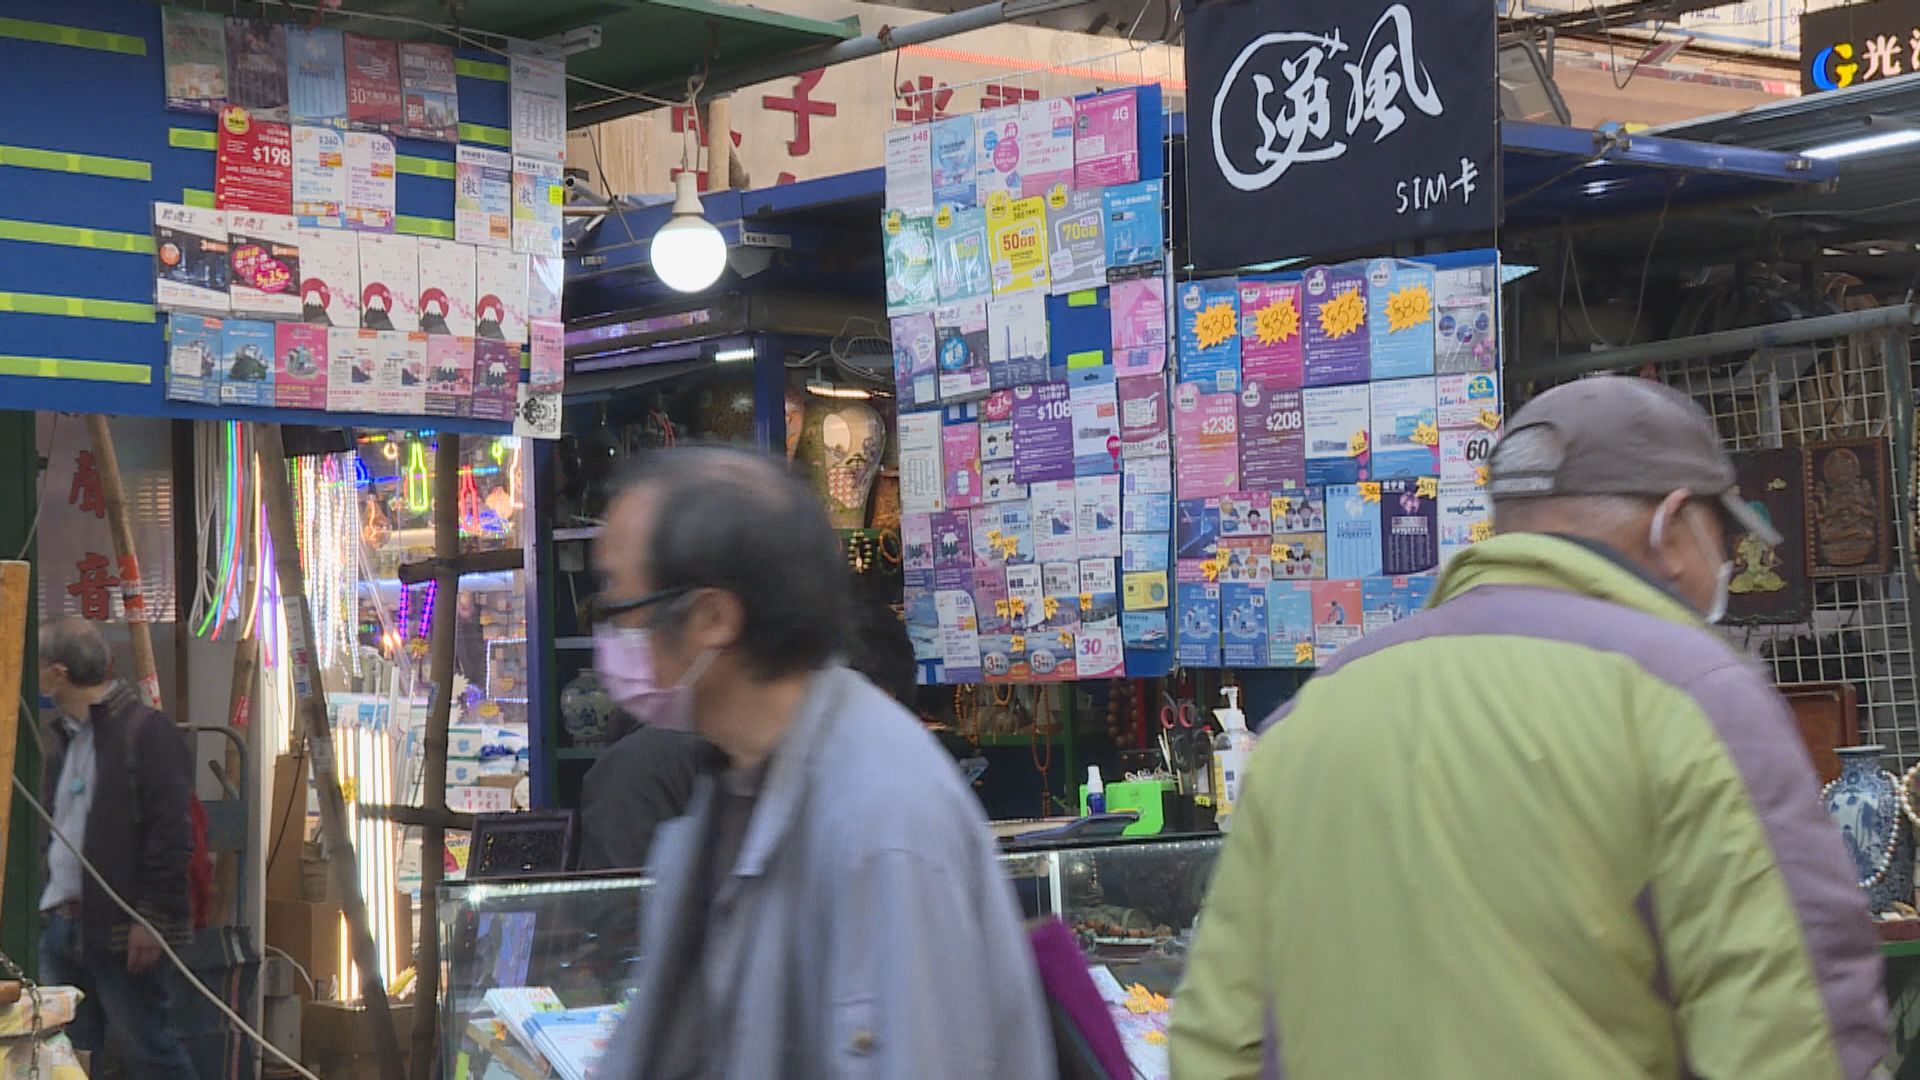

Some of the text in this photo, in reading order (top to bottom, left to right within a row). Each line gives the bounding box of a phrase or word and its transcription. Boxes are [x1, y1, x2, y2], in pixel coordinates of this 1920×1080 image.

[1211, 4, 1443, 191] 逆風
[1112, 106, 1128, 121] 4G
[252, 146, 291, 166] $198
[1397, 158, 1479, 214] SIM卡
[1003, 233, 1036, 251] 50GB
[1062, 222, 1098, 242] 70GB
[1037, 400, 1071, 421] $108
[1202, 415, 1236, 434] $238
[1266, 411, 1301, 431] $208
[1155, 440, 1168, 450] 4G
[1467, 438, 1490, 461] 60
[1080, 638, 1102, 655] 30
